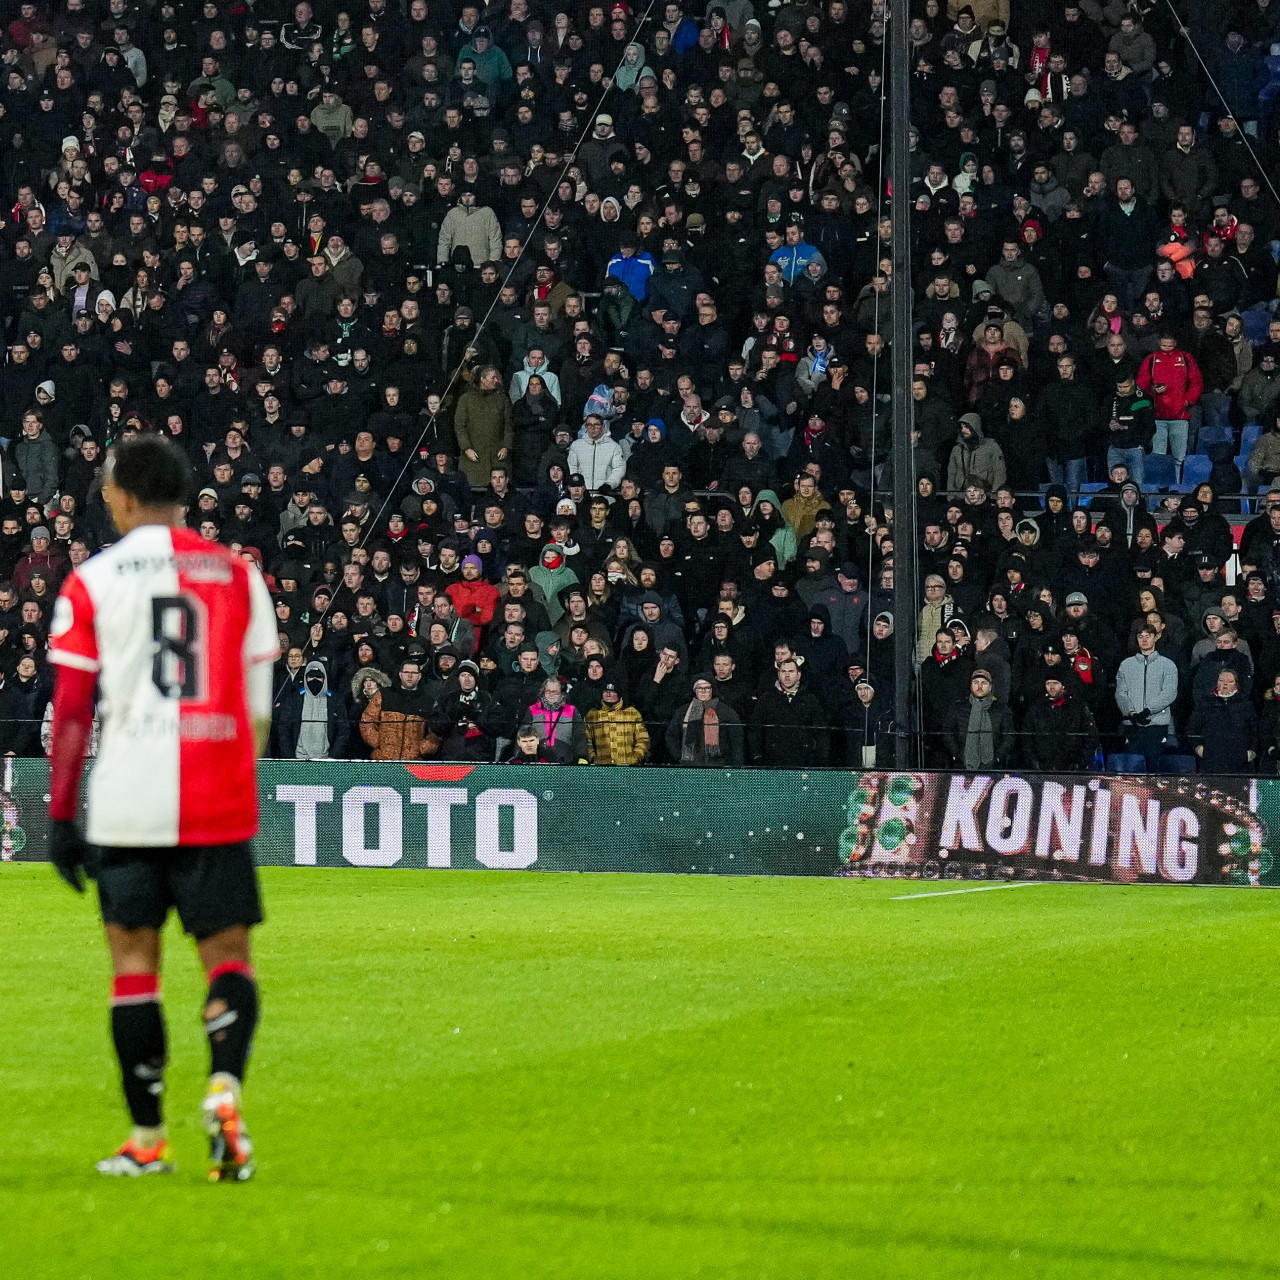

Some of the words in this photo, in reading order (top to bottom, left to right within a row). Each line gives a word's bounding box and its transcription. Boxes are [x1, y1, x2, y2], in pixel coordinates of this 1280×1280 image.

[151, 594, 207, 701] 8
[276, 784, 538, 869] TOTO
[940, 775, 1200, 882] KONING
